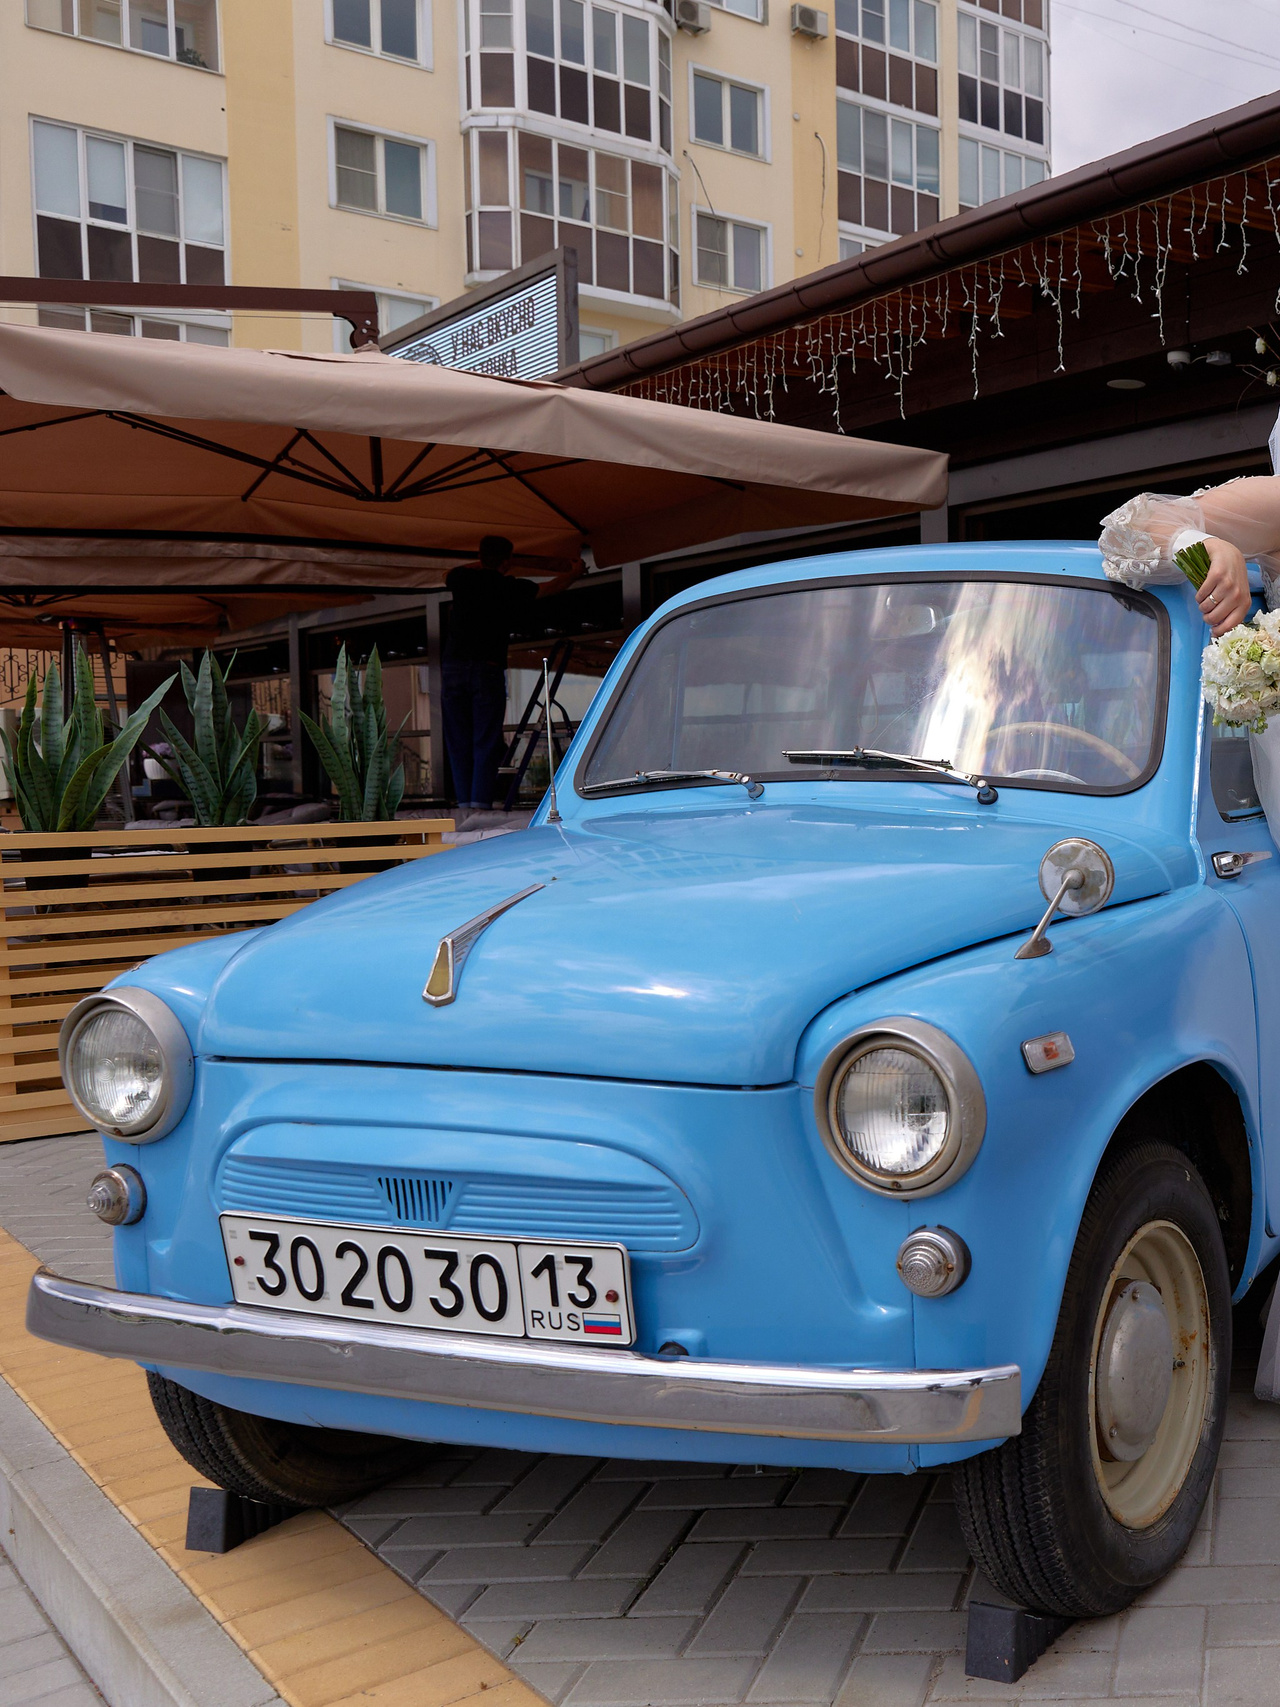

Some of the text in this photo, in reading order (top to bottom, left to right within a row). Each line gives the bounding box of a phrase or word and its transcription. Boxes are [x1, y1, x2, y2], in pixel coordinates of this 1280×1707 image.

[462, 320, 484, 357] НАС
[487, 297, 535, 347] ВКУСНО
[530, 1253, 597, 1310] 13
[530, 1310, 581, 1332] RUS
